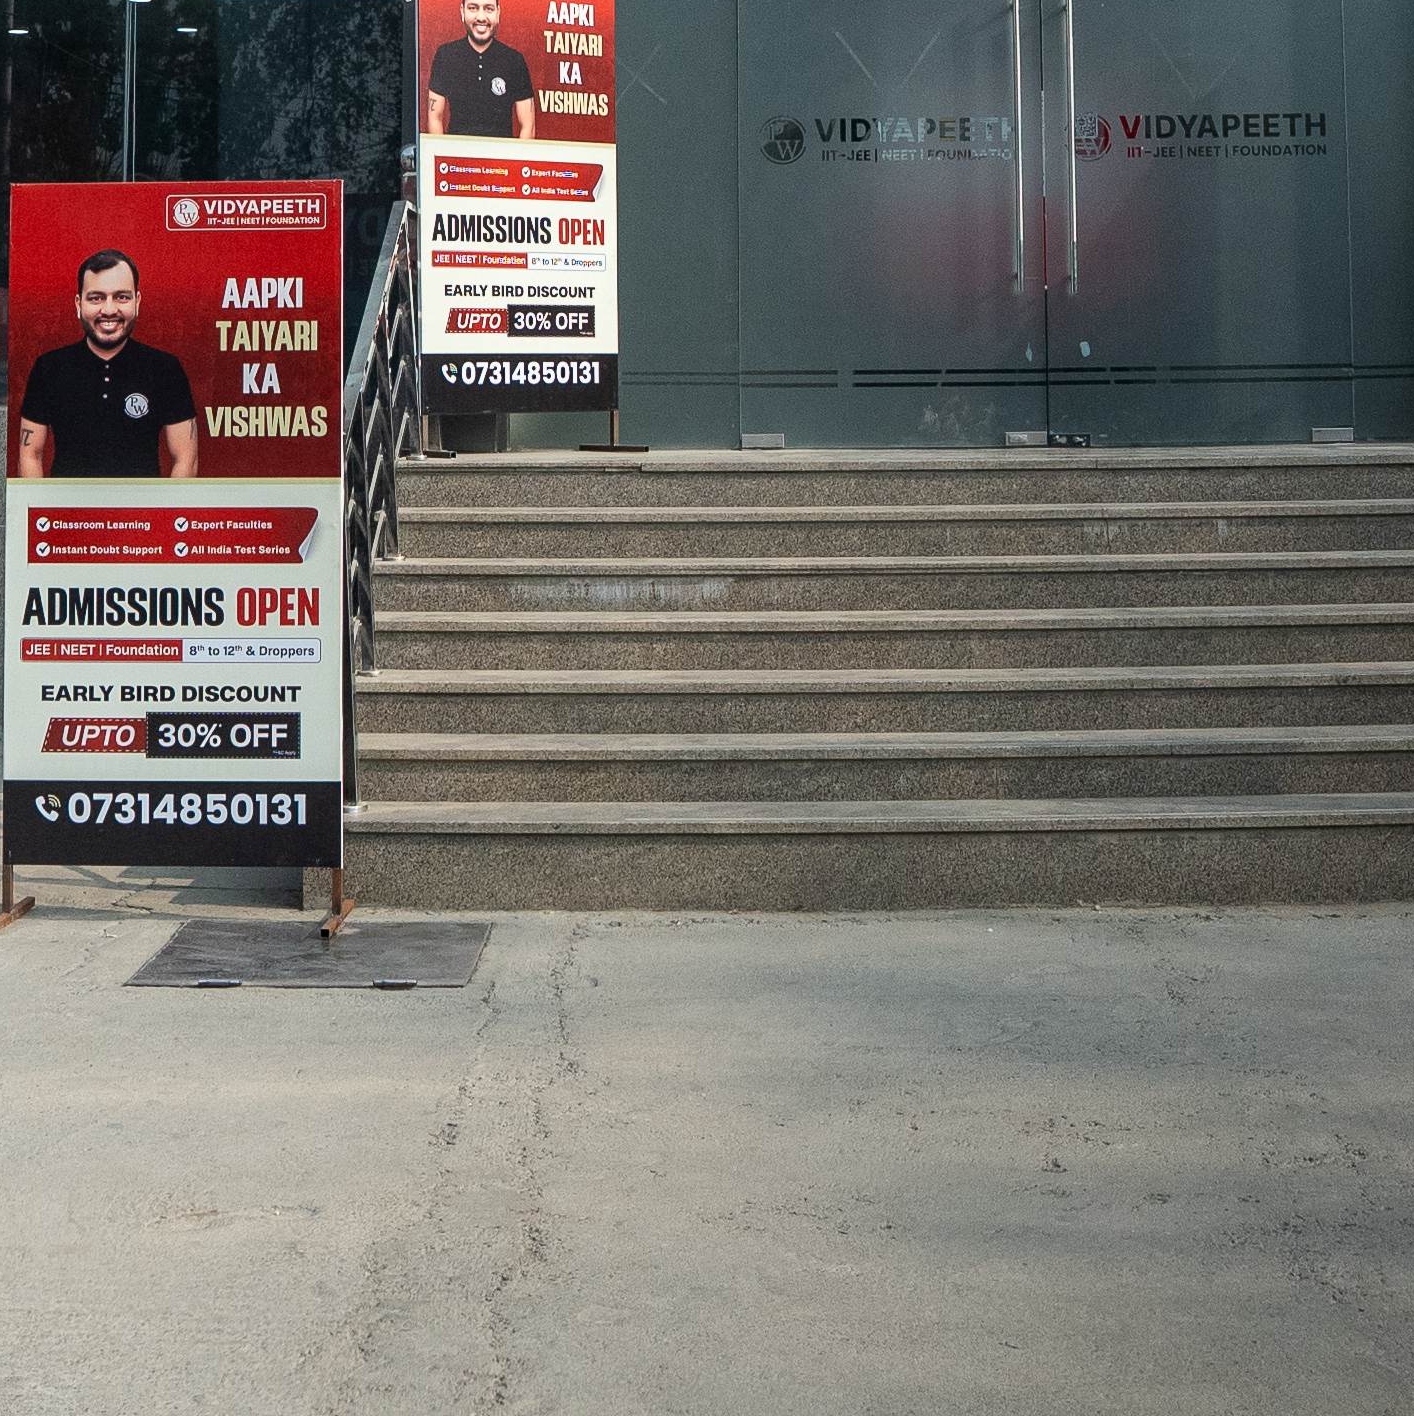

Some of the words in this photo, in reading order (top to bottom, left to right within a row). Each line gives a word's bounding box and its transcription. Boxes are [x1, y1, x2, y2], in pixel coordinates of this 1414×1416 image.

[547, 1, 594, 27] AAPKI
[543, 30, 603, 57] TAIYARI
[559, 61, 583, 85] KA
[538, 90, 609, 117] VISHWAS
[1119, 112, 1327, 140] VIDYAPEETH
[882, 149, 917, 161] NEET
[927, 149, 1013, 161] FOUNDATIO
[1187, 145, 1221, 157] NEET
[1232, 144, 1327, 157] FOUNDATION
[204, 199, 320, 215] VIDYAPEETH
[240, 217, 261, 225] NEET
[265, 217, 320, 225] FOUNDATION
[432, 213, 552, 245] ADMISSIONS
[558, 217, 605, 246] OPEN
[434, 255, 450, 264] JEE
[455, 255, 477, 265] NEET
[482, 255, 526, 266] Foundation
[571, 259, 603, 268] Droppers
[221, 277, 303, 309] AAPKI
[444, 285, 488, 297] EARLY
[491, 285, 524, 298] BIRD
[527, 286, 596, 299] DISCOUNT
[457, 313, 502, 329] UPTO
[555, 312, 589, 330] OFF
[215, 320, 318, 352] TAIYARI
[242, 363, 281, 394] KA
[461, 361, 600, 385] 07314850131
[205, 405, 328, 437] VISHWAS
[52, 520, 105, 530] Classroom
[107, 520, 151, 531] Learning
[191, 520, 224, 532] Expert
[226, 520, 273, 530] Faculties
[52, 545, 88, 554] Instant
[90, 545, 120, 554] Doubt
[122, 545, 163, 556] Support
[191, 545, 205, 554] All
[207, 545, 232, 554] India
[234, 545, 256, 554] Test
[258, 545, 291, 554] Series
[22, 587, 225, 627] ADMISSIONS
[236, 587, 320, 626] OPEN
[26, 644, 51, 656] JEE
[60, 644, 96, 656] NEET
[106, 643, 179, 656] Foundation
[207, 645, 220, 657] to
[245, 646, 256, 657] &
[259, 645, 315, 659] Droppers
[41, 686, 114, 702] EARLY
[120, 686, 176, 702] BIRD
[181, 685, 302, 703] DISCOUNT
[61, 725, 135, 747] UPTO
[230, 724, 288, 748] OFF
[67, 793, 307, 825] 07314850131
